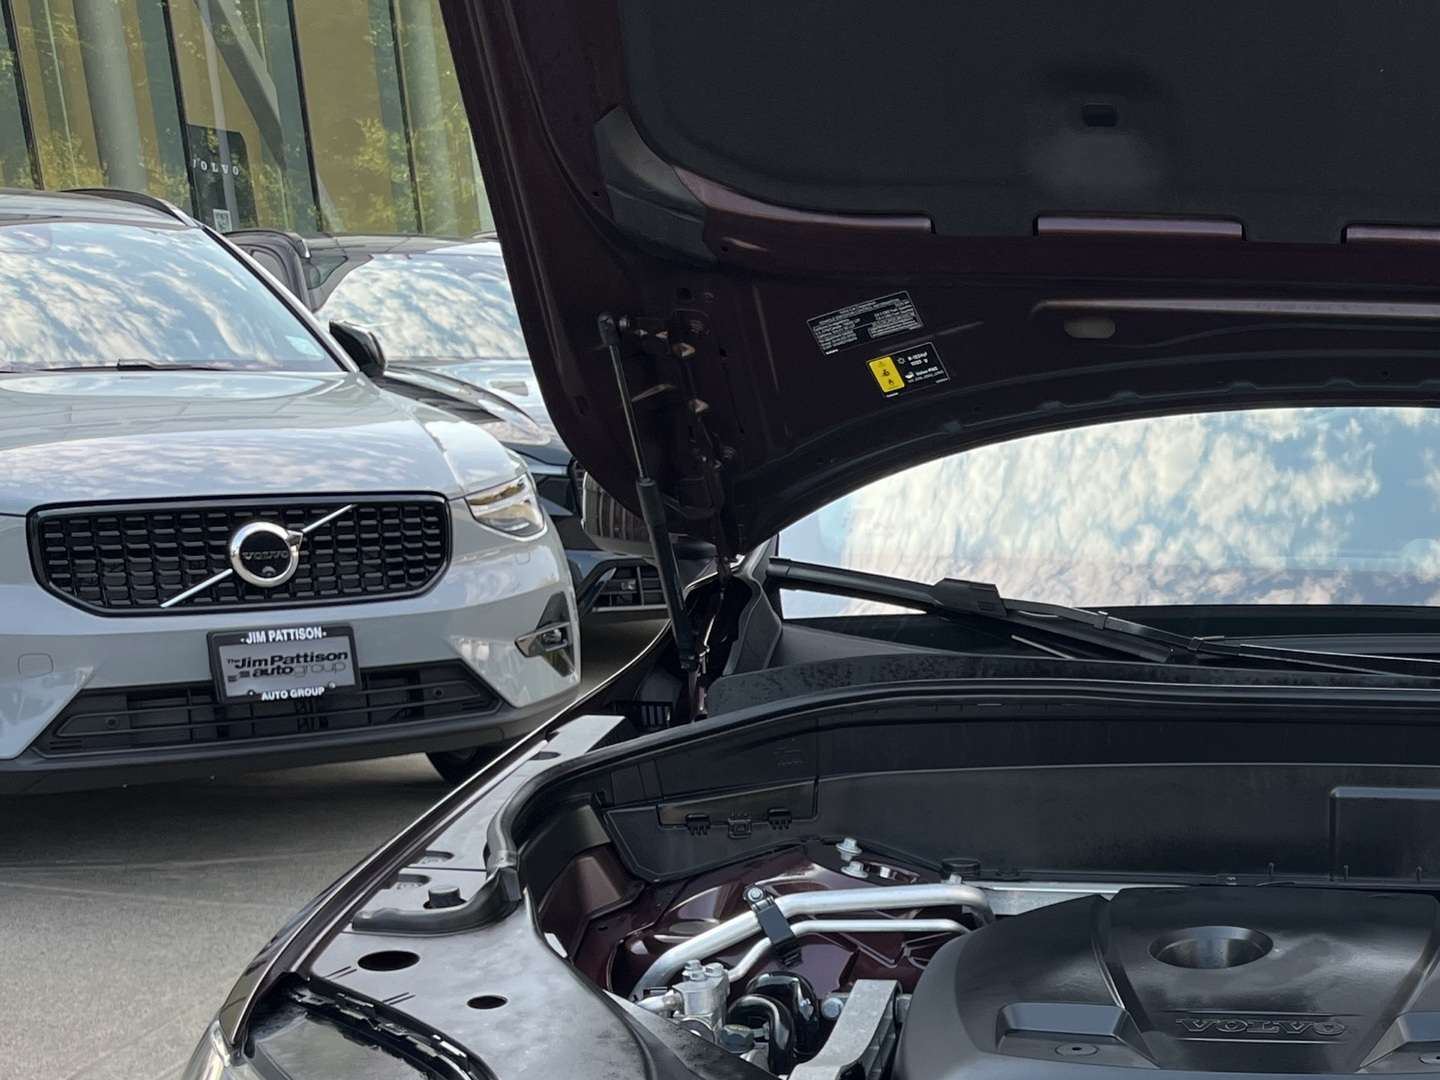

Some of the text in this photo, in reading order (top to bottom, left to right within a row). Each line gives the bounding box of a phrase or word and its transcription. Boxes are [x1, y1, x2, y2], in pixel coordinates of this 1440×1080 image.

[246, 626, 323, 644] JIM PATTISON
[235, 656, 268, 669] Jim
[270, 651, 348, 666] Pattison
[261, 686, 325, 701] AUTO GROUP
[1176, 1018, 1345, 1036] VOLVO
